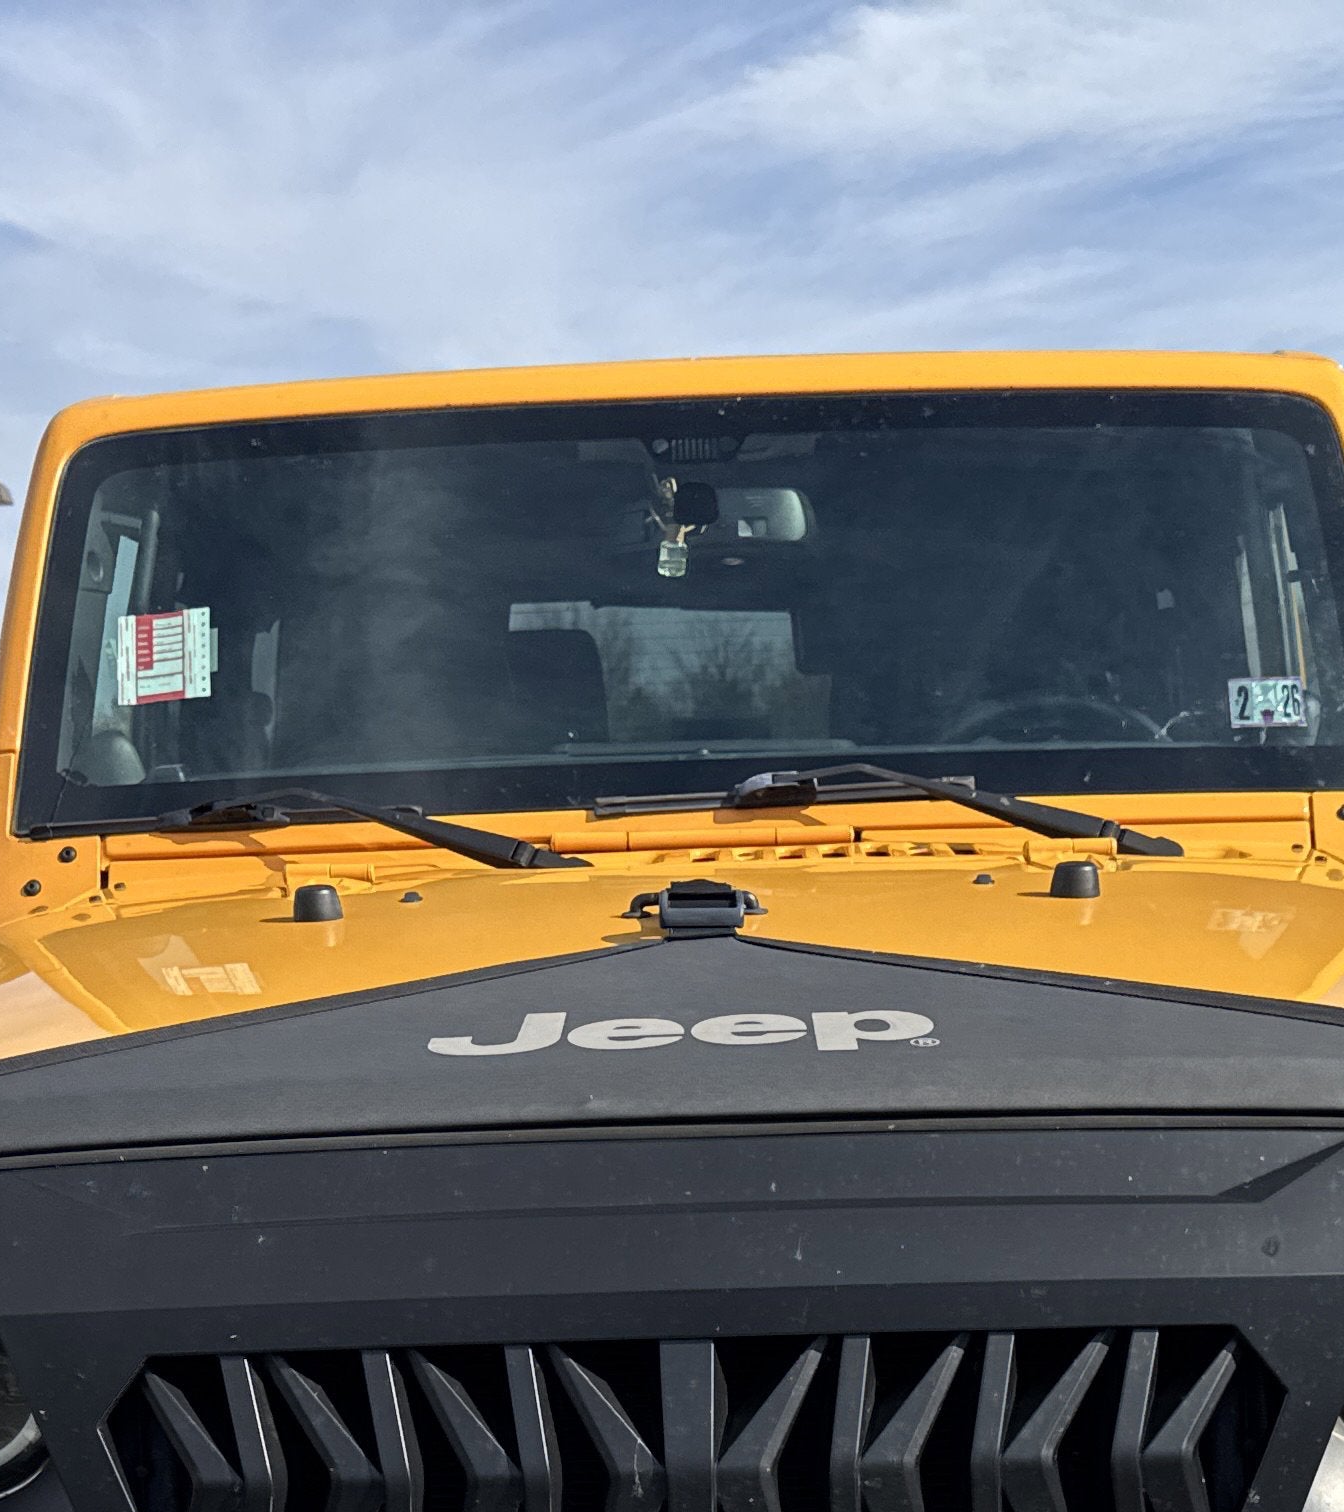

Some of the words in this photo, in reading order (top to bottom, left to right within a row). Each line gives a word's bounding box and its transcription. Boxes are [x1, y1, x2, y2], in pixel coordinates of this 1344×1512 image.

[1237, 685, 1251, 720] 2
[1281, 683, 1301, 718] 26
[427, 1009, 935, 1056] Jeep
